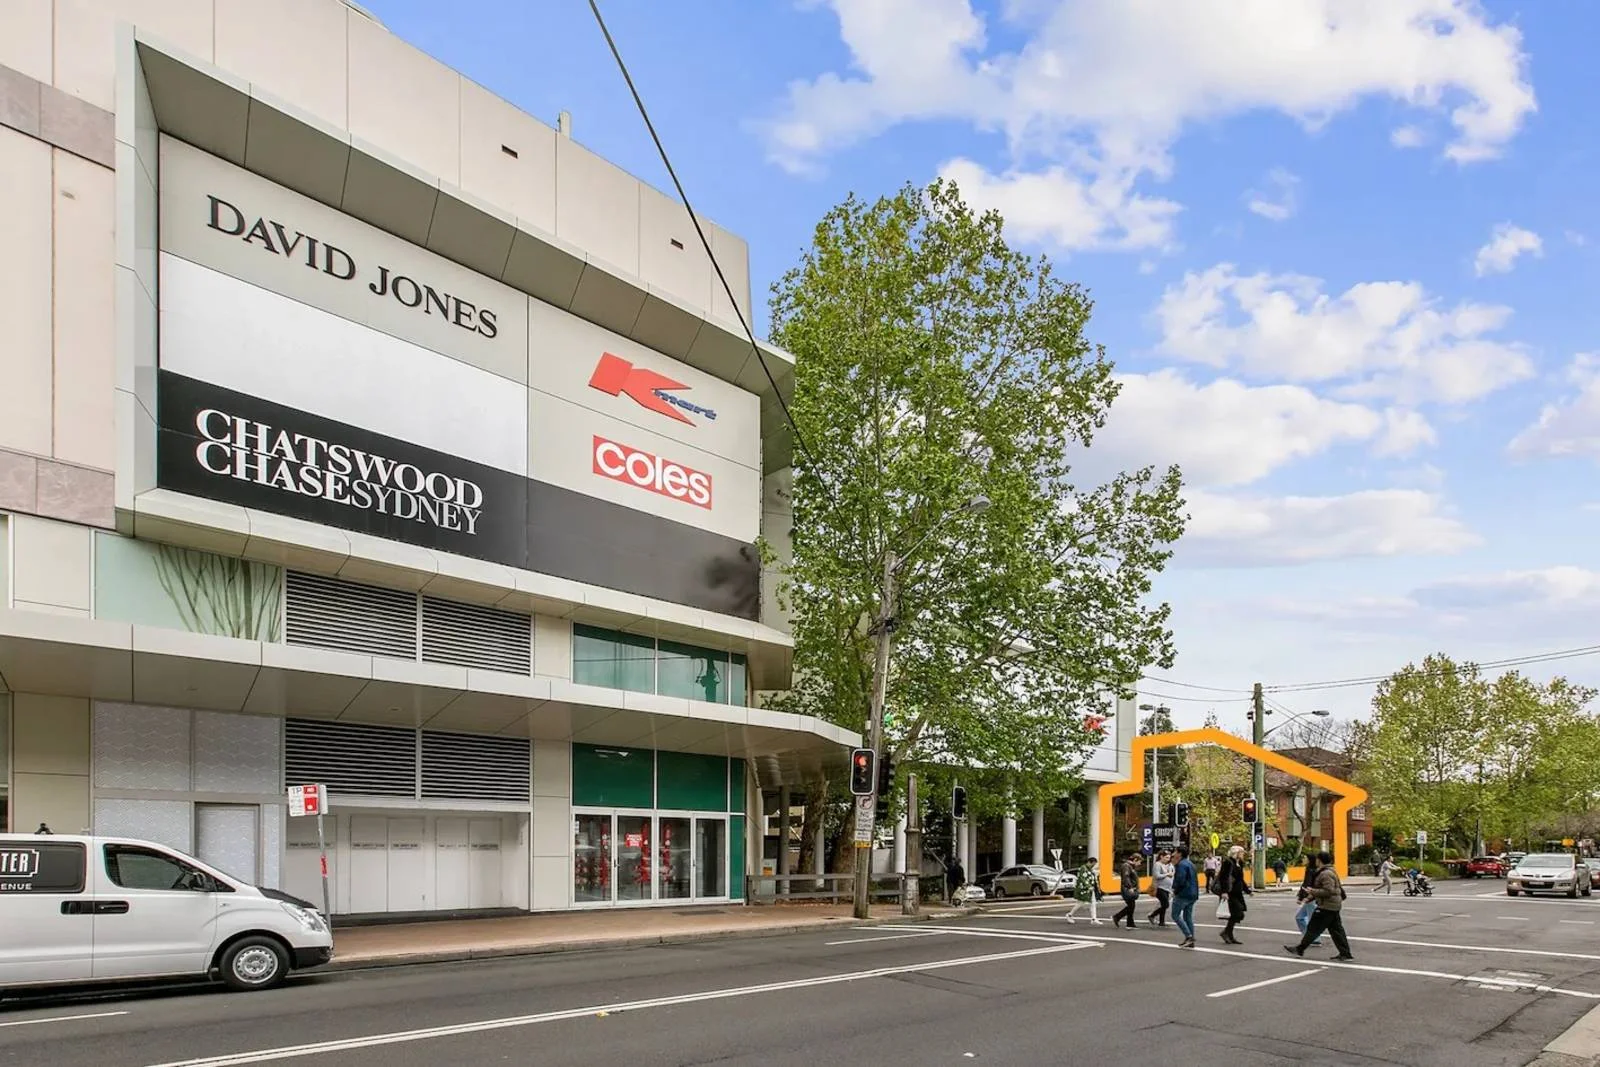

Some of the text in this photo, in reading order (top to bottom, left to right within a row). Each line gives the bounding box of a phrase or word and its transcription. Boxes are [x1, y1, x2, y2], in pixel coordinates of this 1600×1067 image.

[206, 195, 498, 339] DAVID JONES
[196, 408, 483, 509] CHATSWOOD
[596, 442, 710, 505] coles
[1143, 828, 1152, 837] P
[1255, 834, 1262, 843] P
[0, 853, 29, 873] TER
[0, 882, 33, 891] ENUE
